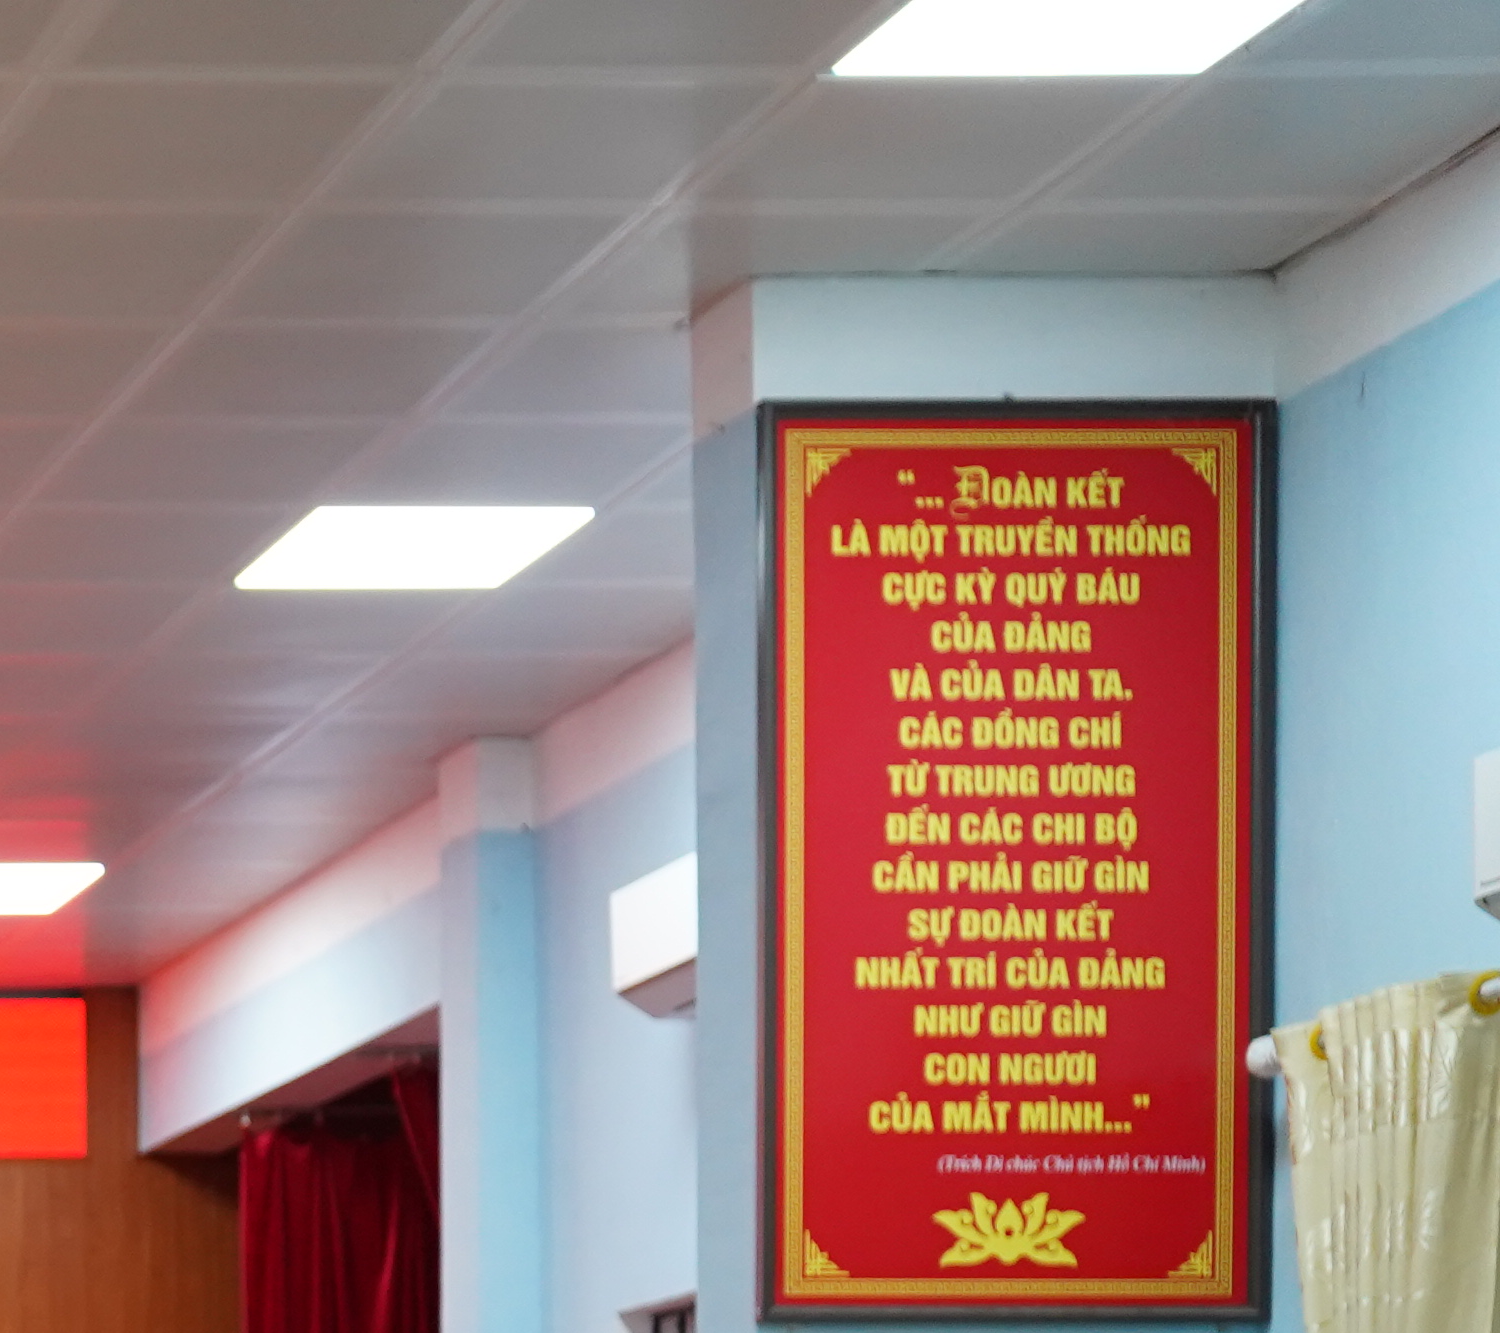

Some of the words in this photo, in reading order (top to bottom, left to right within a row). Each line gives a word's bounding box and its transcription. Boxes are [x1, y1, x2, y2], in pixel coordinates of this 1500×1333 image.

[951, 465, 1057, 519] ĐOÀN
[1067, 469, 1124, 507] KẾT
[831, 519, 871, 556] LÀ
[879, 519, 948, 562] MỘT
[956, 516, 1077, 556] TRUYỀN
[1087, 515, 1190, 556] THỐNG
[882, 570, 946, 611] CỰC
[955, 567, 996, 604] KỲ
[1005, 567, 1066, 607] QUÝ
[1076, 567, 1139, 604] BÁU
[931, 612, 996, 653] CỦA
[1003, 612, 1091, 653] ĐẢNG
[890, 663, 932, 701] VÀ
[940, 659, 1005, 701] CỦA
[1013, 663, 1079, 701] DÂN
[898, 711, 963, 749] CÁC
[971, 707, 1059, 749] ĐỒNG
[1068, 711, 1121, 749] CHÍ
[887, 759, 930, 797] TỪ
[935, 765, 1039, 797] TRUNG
[1048, 762, 1135, 797] ƯƠNG
[885, 804, 950, 845] ĐẾN
[959, 807, 1023, 845] CÁC
[1032, 813, 1085, 845] CHI
[1095, 807, 1137, 850] BỘ
[872, 851, 939, 893] CẦN
[947, 852, 1022, 893] PHẢI
[1031, 856, 1089, 893] GIỮ
[1094, 855, 1149, 892] GÌN
[907, 906, 955, 946] SỰ
[958, 903, 1046, 941] ĐOÀN
[1056, 900, 1114, 941] KẾT
[855, 947, 940, 989] NHẤT
[947, 951, 996, 989] TRÍ
[1005, 948, 1070, 989] CỦA
[1078, 948, 1165, 989] ĐẢNG
[914, 1002, 984, 1037] NHƯ
[989, 1000, 1046, 1037] GIỮ
[1051, 1000, 1106, 1037] GÌN
[924, 1053, 990, 1085] CON
[999, 1051, 1096, 1085] NGƯƠI
[869, 1092, 933, 1132] CỦA
[942, 1091, 1011, 1132] MẮT
